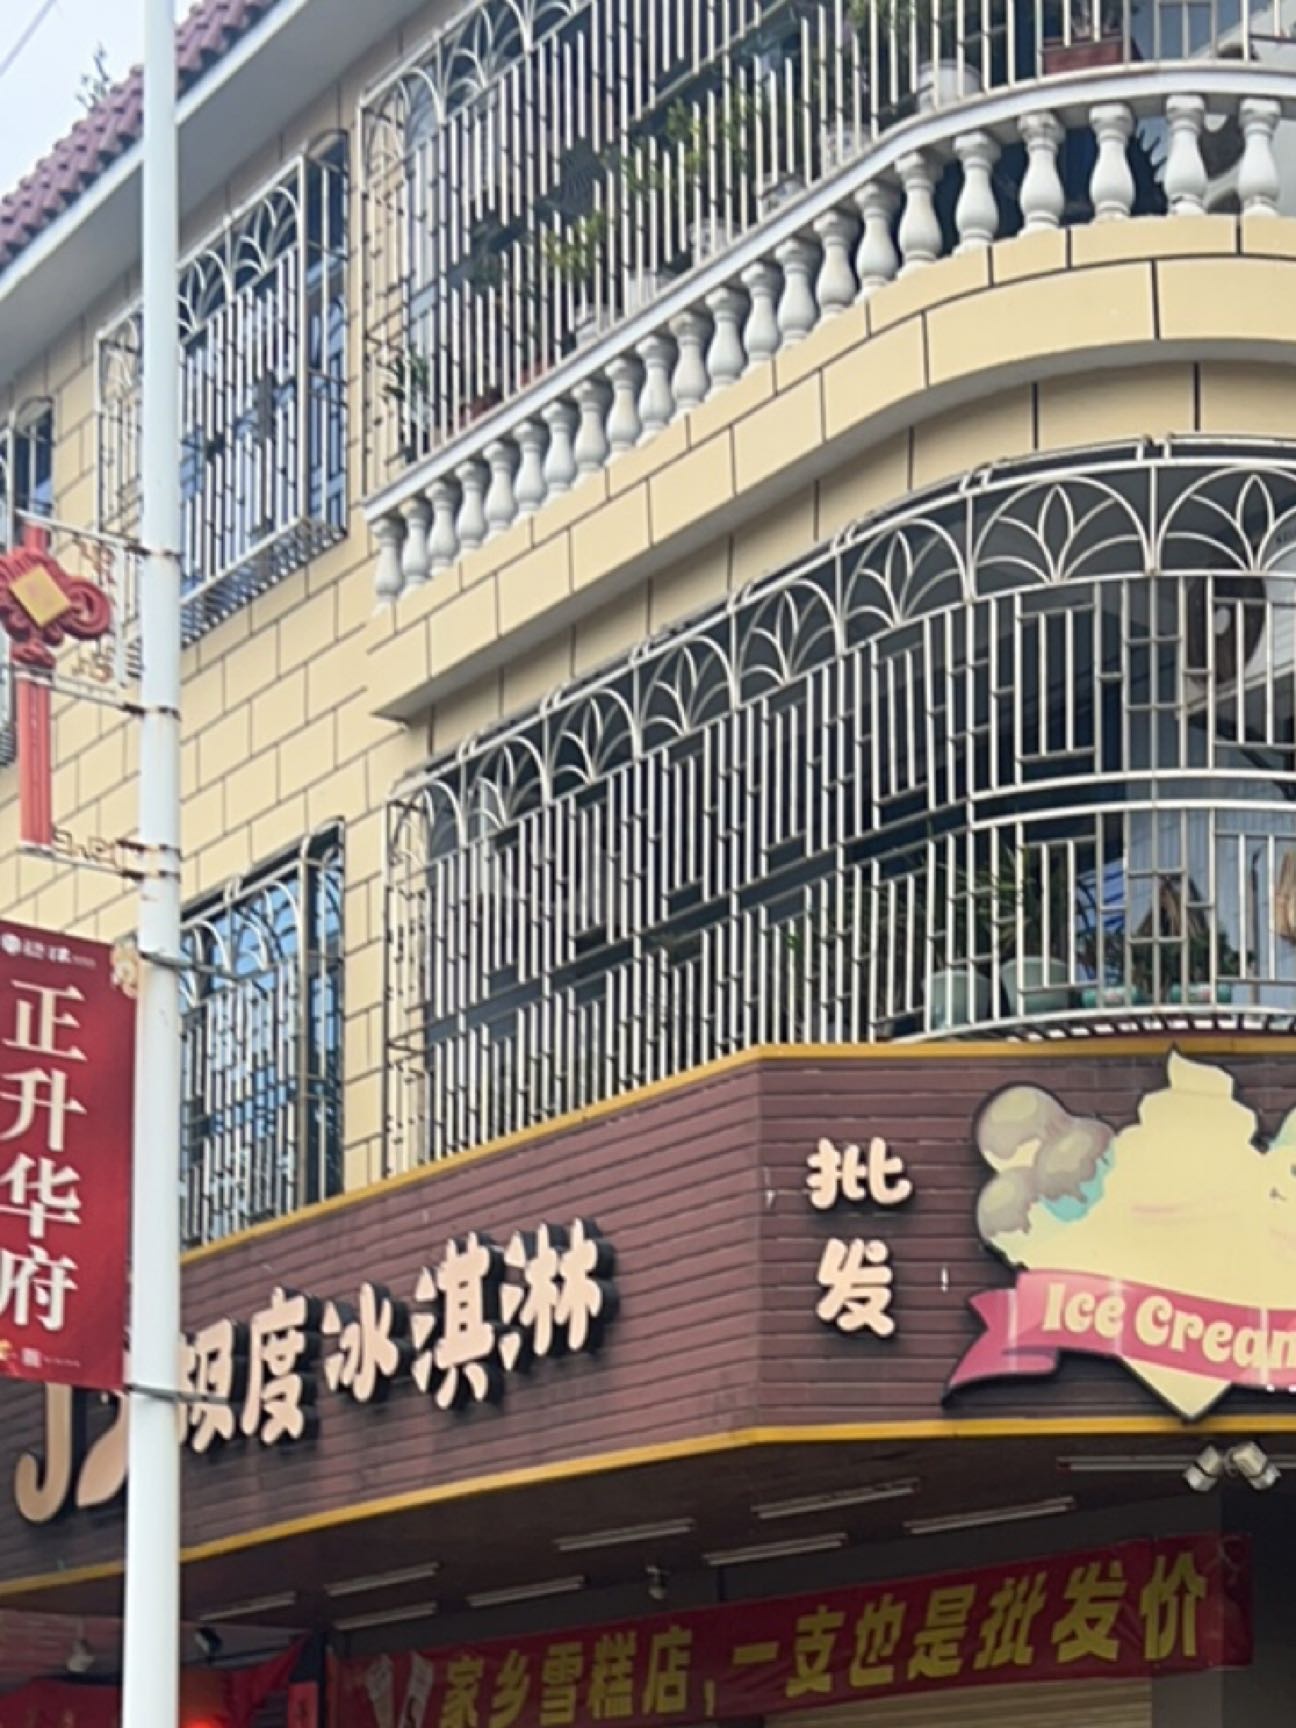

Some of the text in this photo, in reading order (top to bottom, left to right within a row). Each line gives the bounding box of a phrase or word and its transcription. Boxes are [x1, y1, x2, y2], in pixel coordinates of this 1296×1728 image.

[0, 979, 87, 1331] 正升华府
[806, 1137, 913, 1338] 批发
[1041, 1282, 1126, 1339] Ice
